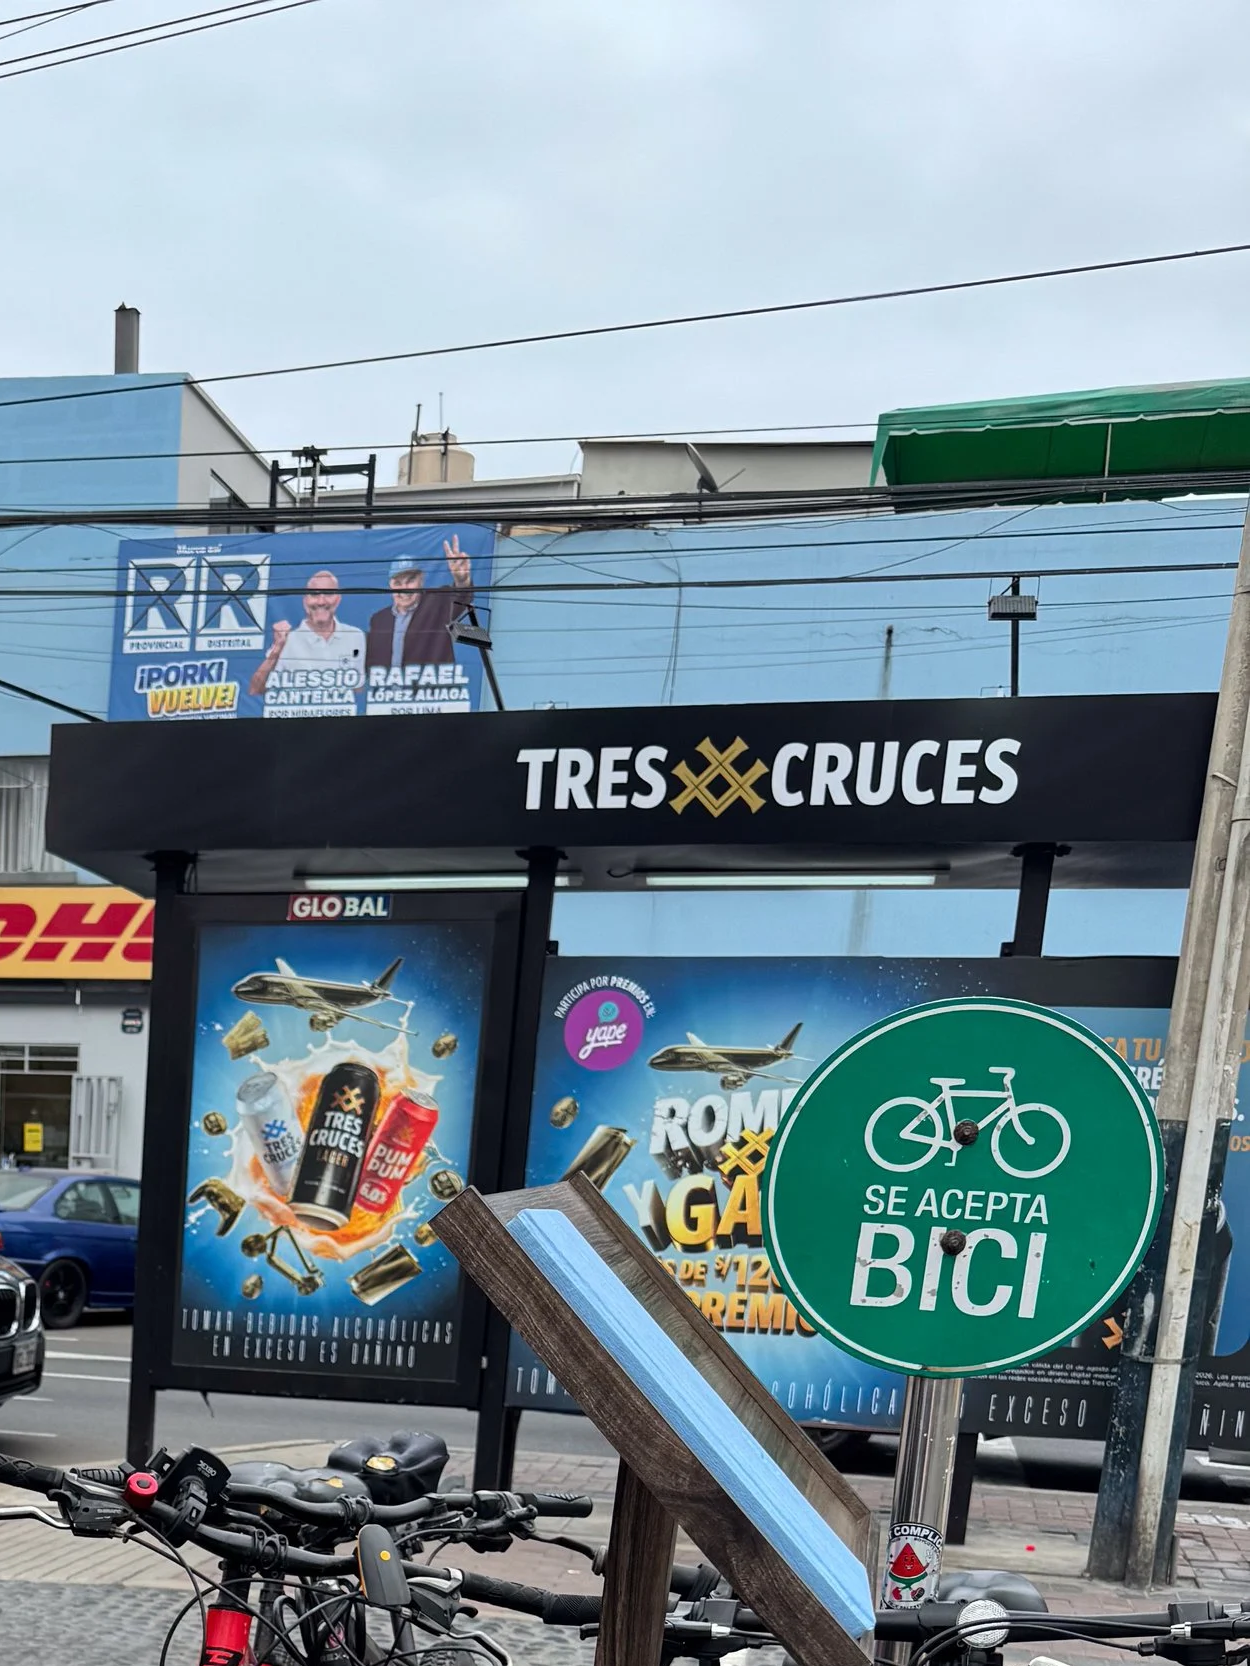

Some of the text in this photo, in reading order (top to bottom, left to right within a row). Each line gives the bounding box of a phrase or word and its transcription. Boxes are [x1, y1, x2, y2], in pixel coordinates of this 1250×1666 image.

[130, 638, 252, 651] PROVINCIAL DISTRITAL
[369, 664, 470, 687] RAFAEL
[149, 684, 236, 715] VUELVE!
[264, 689, 355, 705] CANTELLA
[366, 686, 470, 702] LÓPEZ ALIAGA
[516, 737, 1023, 811] TRES CRUCES
[293, 896, 388, 918] GLOBAL
[554, 981, 591, 1019] PARTICIPA
[590, 976, 610, 989] POR
[610, 976, 650, 1004] PREMIOS
[578, 1023, 628, 1060] yape
[324, 1111, 364, 1135] TRES
[309, 1128, 365, 1159] CRUCES
[374, 1144, 414, 1165] PUM
[366, 1159, 407, 1180] PUM
[666, 1173, 762, 1247] GA
[863, 1184, 1049, 1225] SE ACEPTA
[679, 1259, 708, 1283] DE
[850, 1222, 1047, 1319] BICI
[182, 1308, 454, 1345] TOMAR BEBIDAS ALCOHÓLICAS
[212, 1335, 416, 1369] EN EXCESO ES DAÑINO
[988, 1393, 1087, 1428] EXCESO
